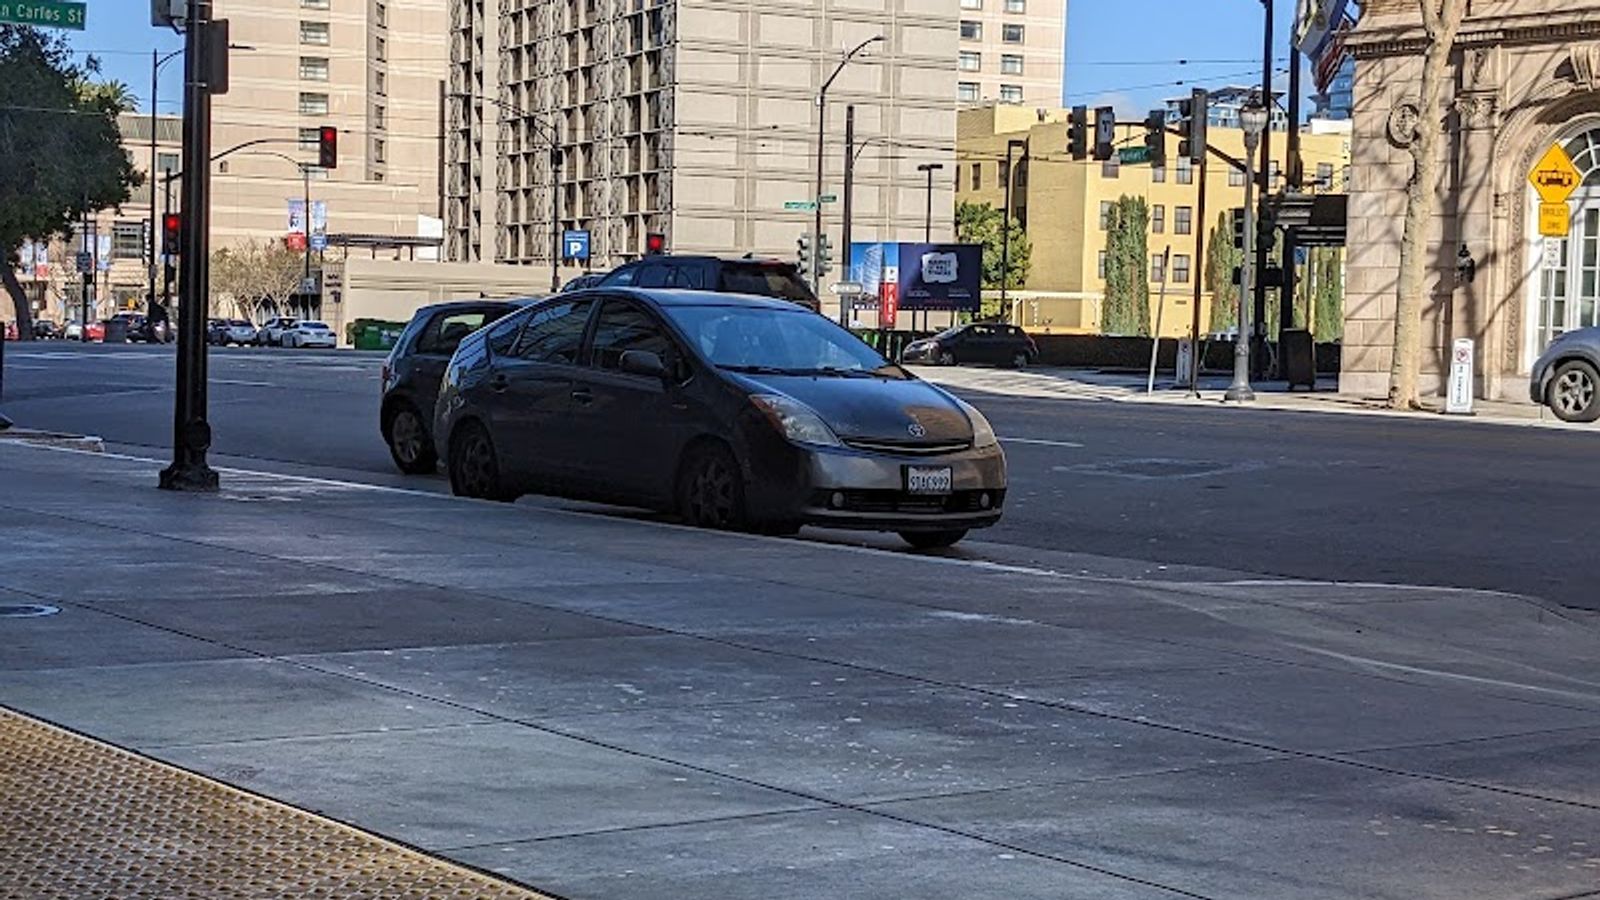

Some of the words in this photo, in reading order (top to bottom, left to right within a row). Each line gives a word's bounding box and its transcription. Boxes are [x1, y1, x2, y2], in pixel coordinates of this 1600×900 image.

[17, 3, 60, 22] Carlos
[67, 7, 82, 24] St
[570, 242, 582, 256] P
